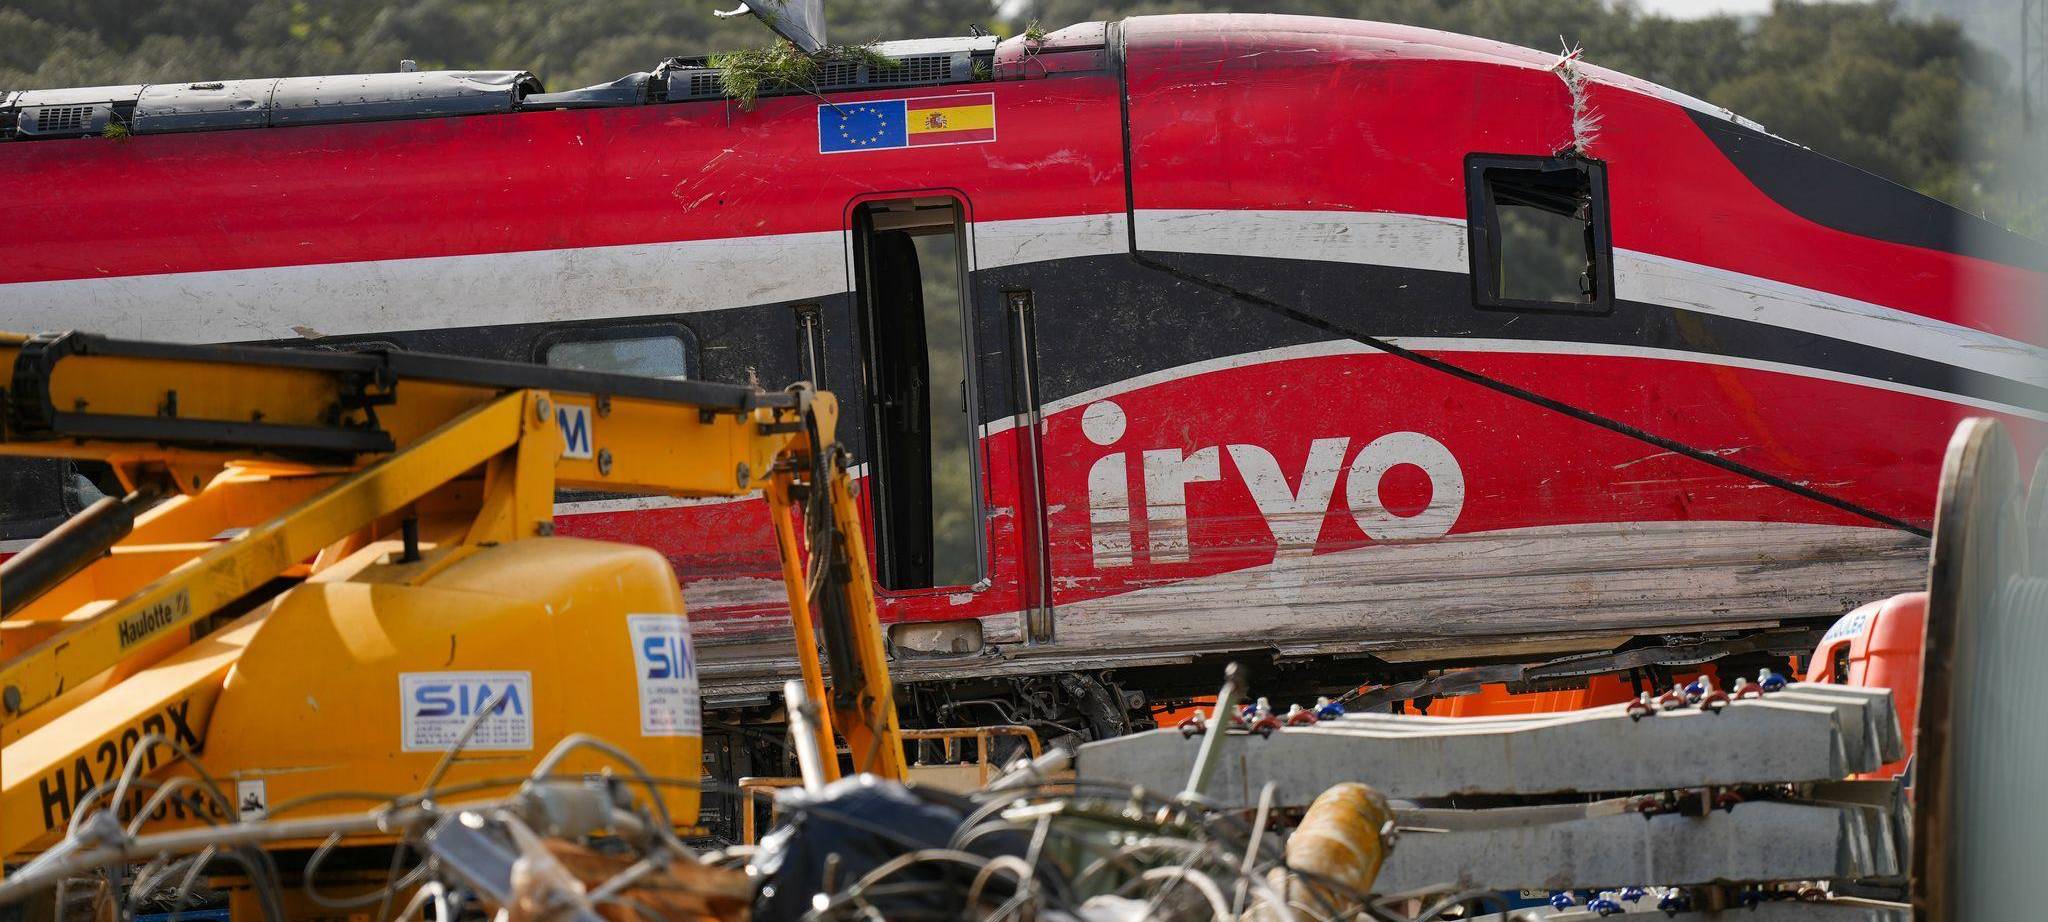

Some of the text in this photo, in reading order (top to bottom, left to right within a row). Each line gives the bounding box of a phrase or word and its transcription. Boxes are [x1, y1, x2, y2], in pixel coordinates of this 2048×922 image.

[1081, 400, 1465, 572] iryo
[119, 603, 173, 648] Haulotte
[415, 684, 524, 717] SIM
[38, 698, 202, 832] HA20PX
